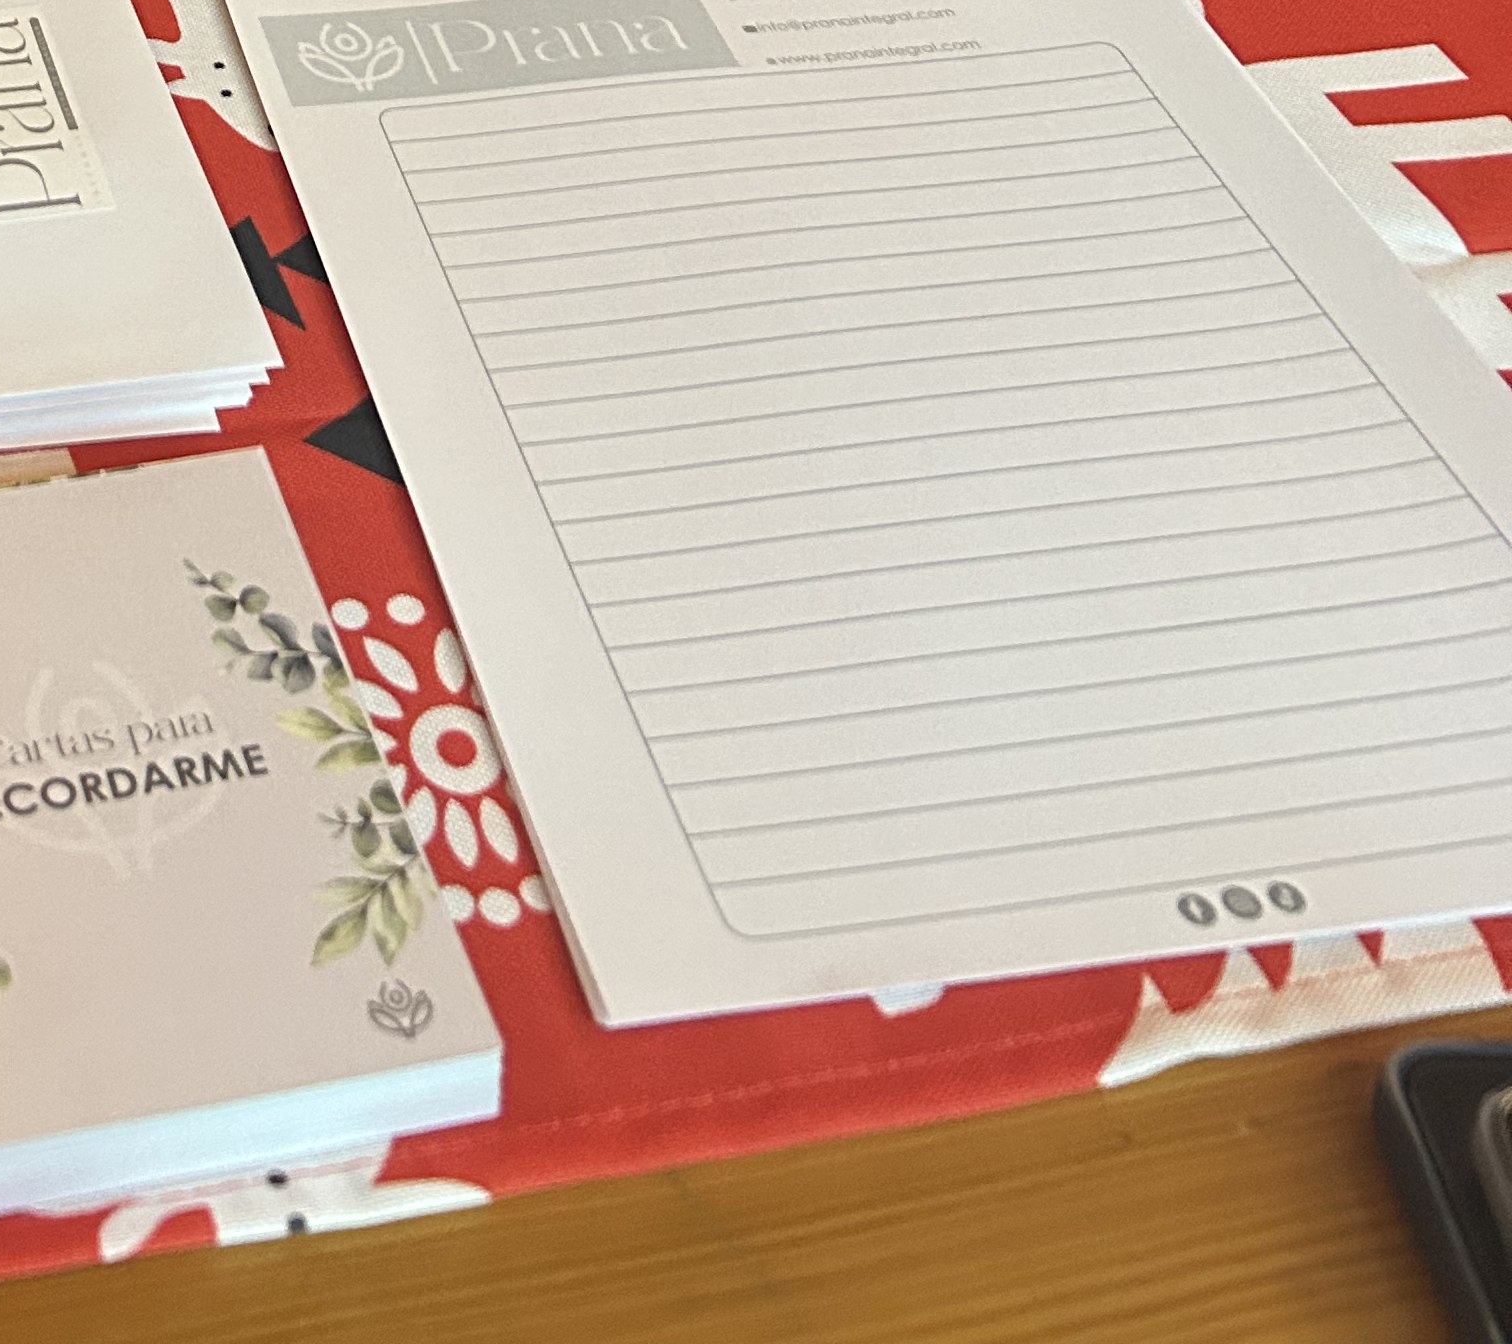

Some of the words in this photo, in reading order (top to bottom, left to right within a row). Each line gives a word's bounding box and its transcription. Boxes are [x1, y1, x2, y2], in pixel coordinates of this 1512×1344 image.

[756, 7, 956, 33] info@pranaintegral.com
[427, 14, 690, 73] Prana
[126, 711, 215, 756] para
